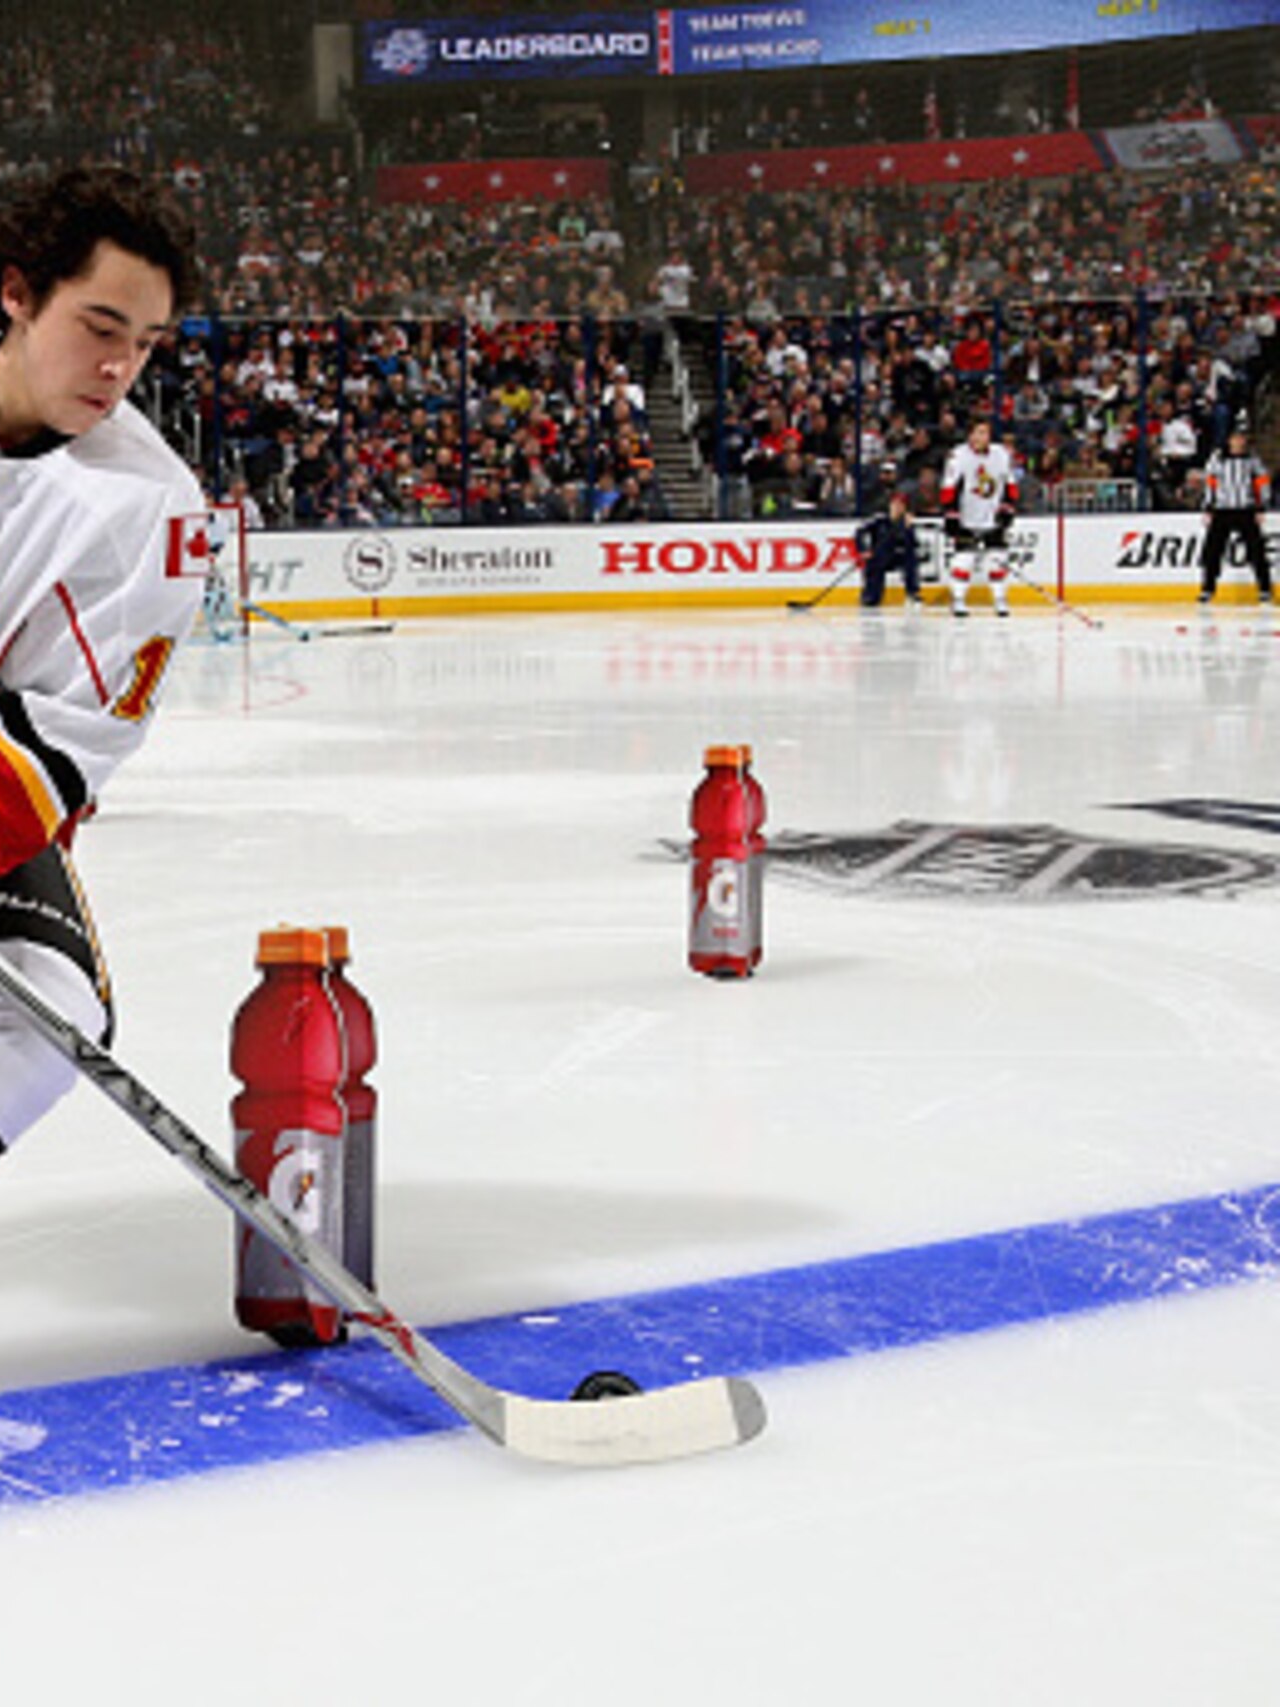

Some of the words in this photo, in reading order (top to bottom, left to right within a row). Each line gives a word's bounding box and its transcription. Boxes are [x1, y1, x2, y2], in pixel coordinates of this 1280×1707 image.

[440, 32, 650, 61] LEADERBOARD
[407, 546, 552, 574] Sheraton
[600, 536, 862, 575] HONDA
[109, 633, 177, 725] 1
